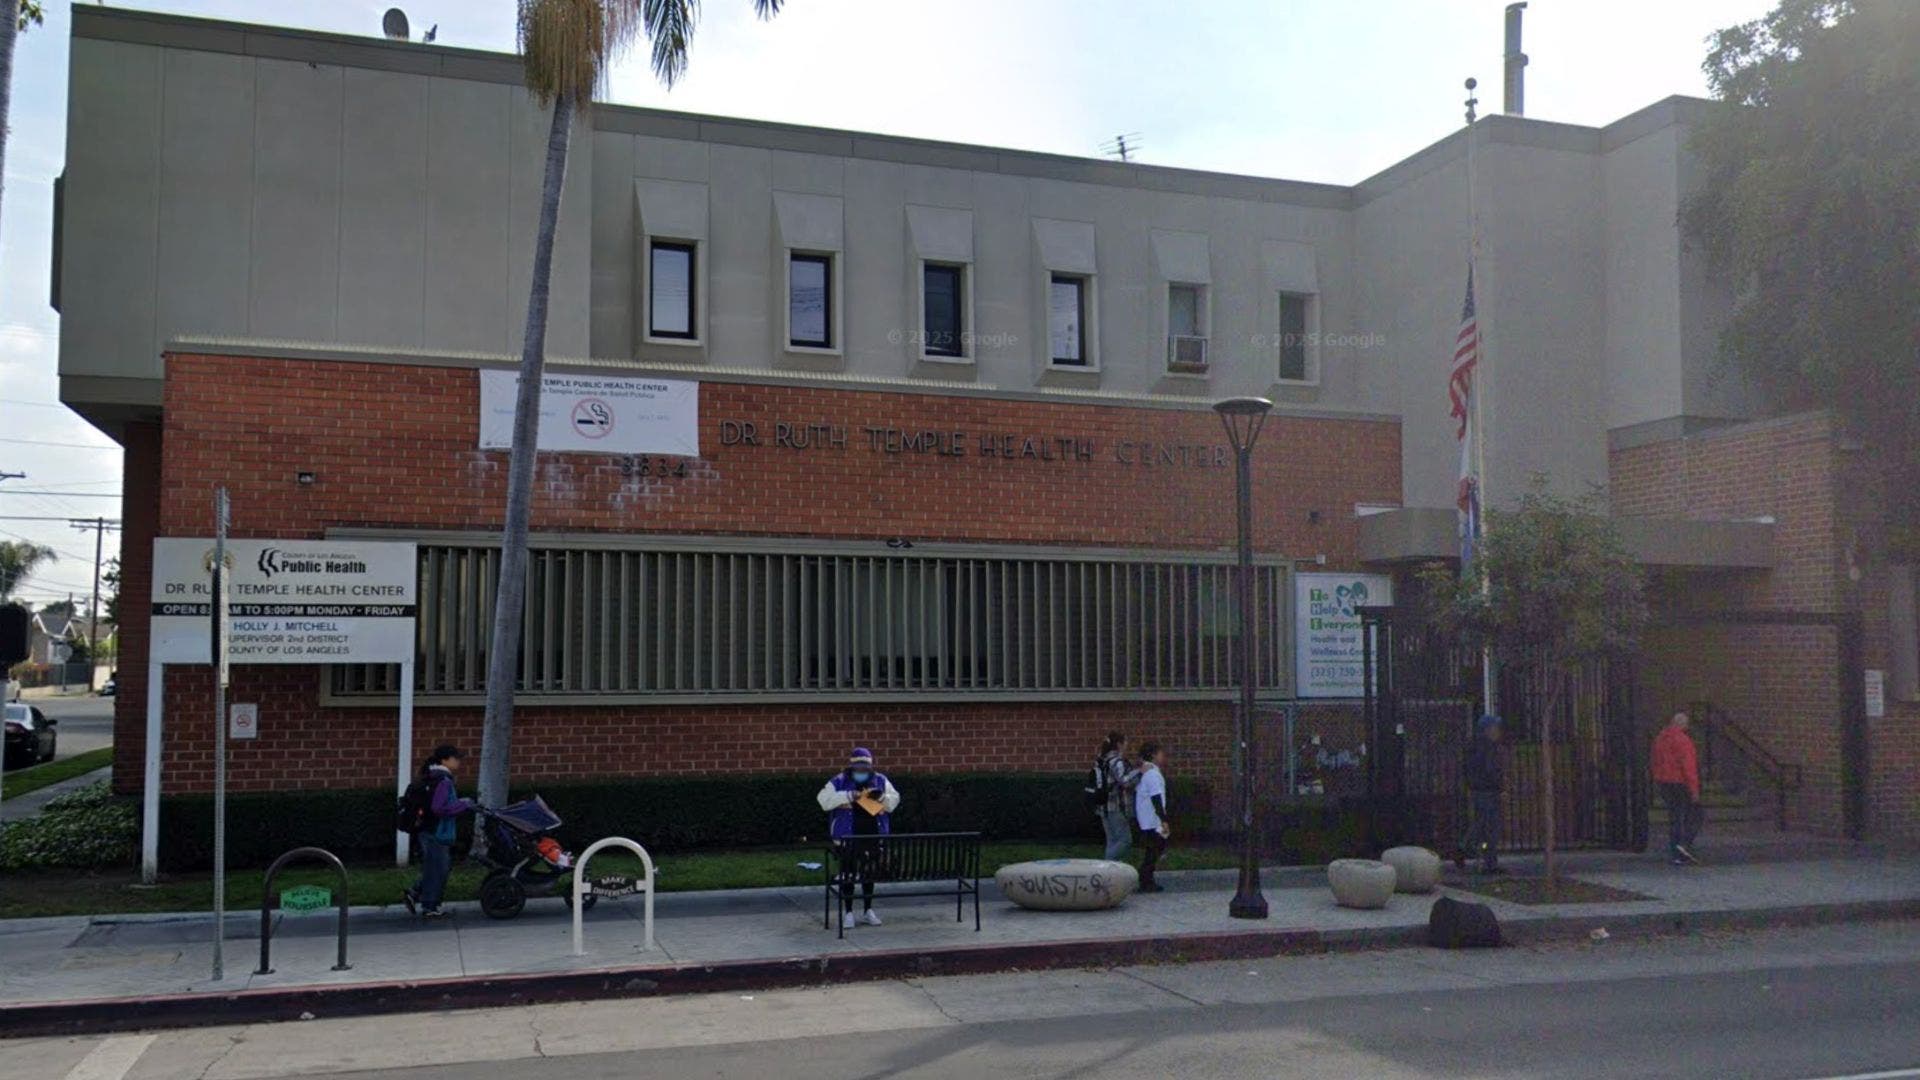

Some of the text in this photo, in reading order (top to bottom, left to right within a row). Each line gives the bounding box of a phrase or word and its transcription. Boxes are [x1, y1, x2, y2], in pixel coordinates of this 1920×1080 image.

[541, 379, 668, 392] EMPLE PUBLIC HEALTH CENTER
[775, 422, 848, 449] RUTH
[866, 426, 966, 455] TEMPLE
[979, 434, 1093, 462] HEALTH
[1116, 440, 1230, 467] CENTER
[281, 560, 366, 573] Public Health
[165, 583, 187, 594] DR
[237, 584, 289, 595] TEMPLE
[296, 585, 346, 596] HEALTH
[351, 585, 405, 596] CENTER
[1311, 588, 1329, 601] To
[163, 604, 197, 614] OPEN
[245, 605, 261, 615] TO
[263, 605, 304, 615] 5:00PM
[307, 606, 356, 615] MONDAY
[365, 606, 405, 615] FRIDAY
[1311, 603, 1339, 617] Help
[233, 622, 338, 631] HOLLY J. MITCHELL
[1311, 618, 1364, 632] Everyon
[227, 634, 348, 643] UPERVISOR 2nd DISTRICT
[228, 646, 350, 655] OUNTY OF LOS ANGELES
